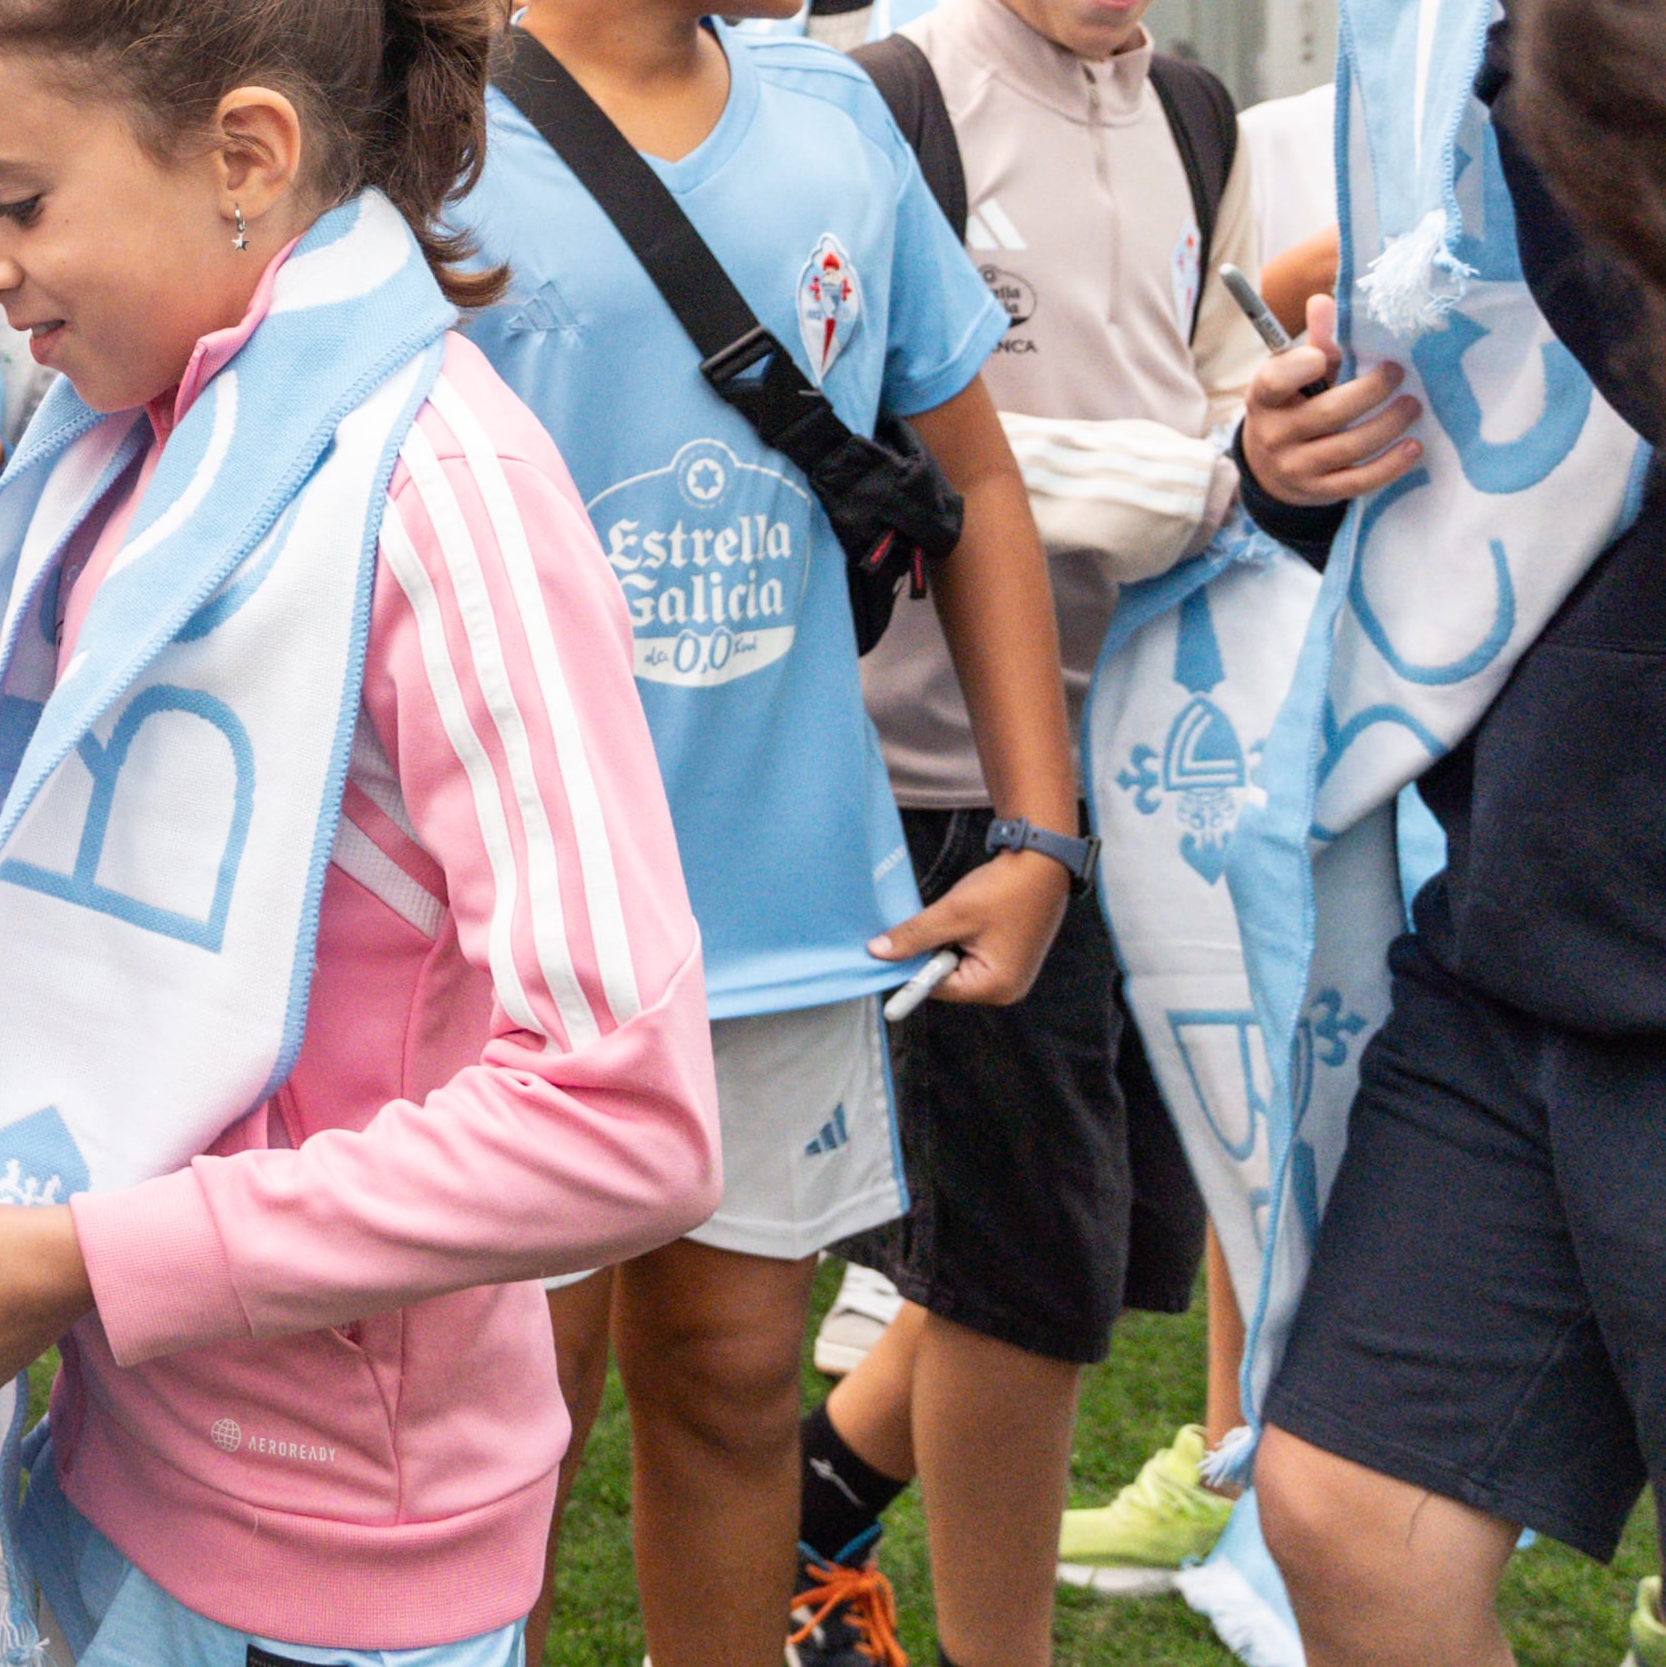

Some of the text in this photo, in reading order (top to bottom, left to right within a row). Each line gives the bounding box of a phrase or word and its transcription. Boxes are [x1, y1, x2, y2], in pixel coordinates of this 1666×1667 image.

[607, 513, 793, 571] Estrella
[619, 569, 785, 627] Galicia
[673, 627, 733, 674] 0,0
[248, 1435, 336, 1462] AEROREADY
